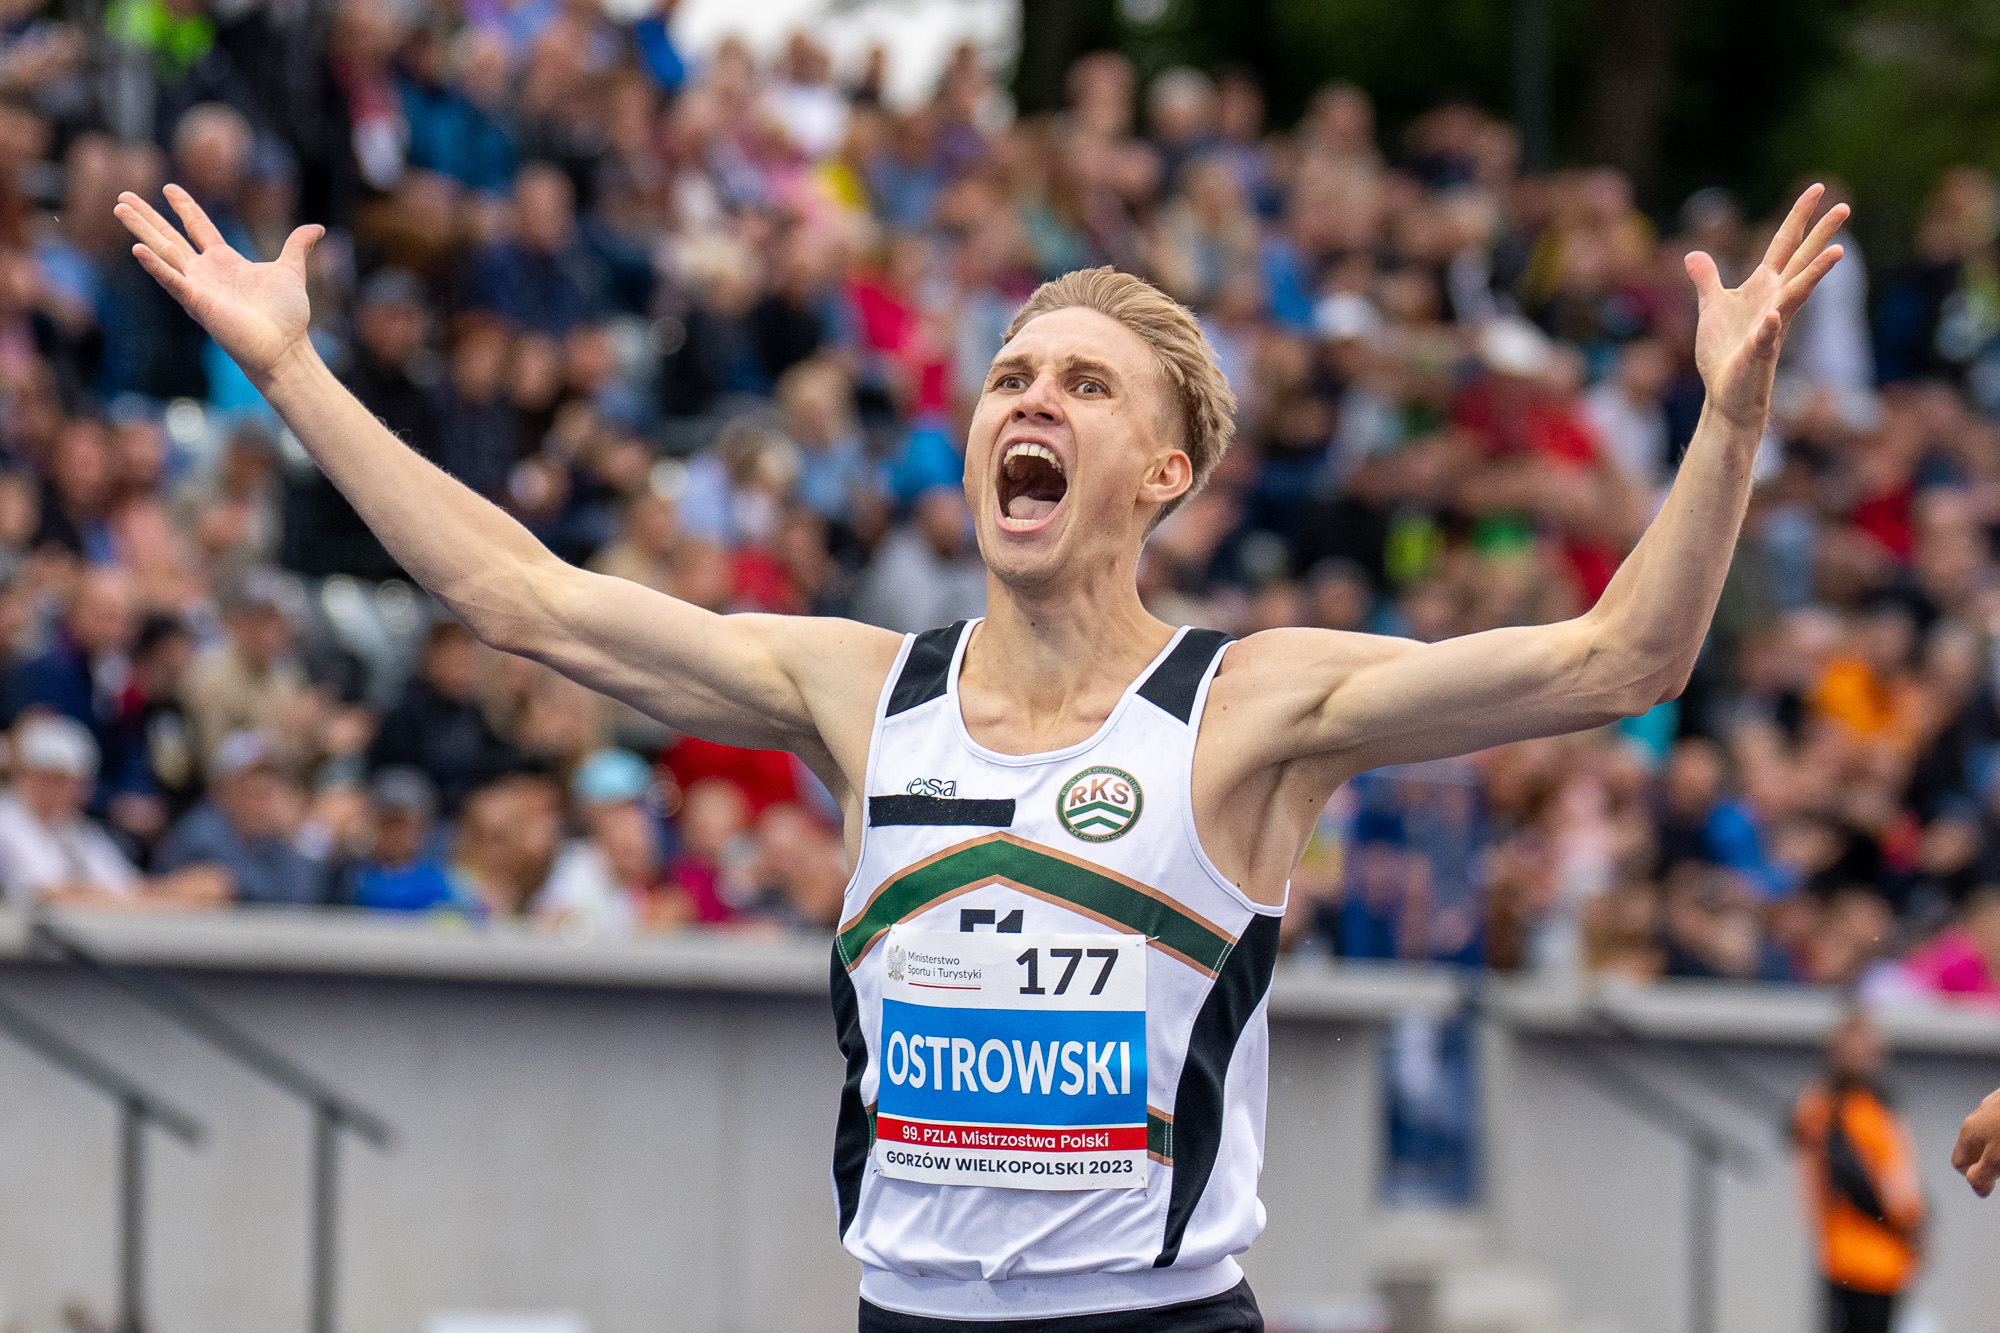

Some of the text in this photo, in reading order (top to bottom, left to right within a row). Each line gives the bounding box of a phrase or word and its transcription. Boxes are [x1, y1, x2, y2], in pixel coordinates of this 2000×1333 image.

[1069, 777, 1130, 807] RKS
[908, 951, 960, 966] Ministerstwo
[907, 964, 982, 980] Sportu i Turystyki
[1016, 947, 1119, 995] 177
[887, 1030, 1131, 1095] OSTROWSKI
[902, 1125, 1109, 1149] 99. PZLA Mistrzostwa Polski
[886, 1151, 1133, 1175] GORZÓW WIELKOPOLSKI 2023
